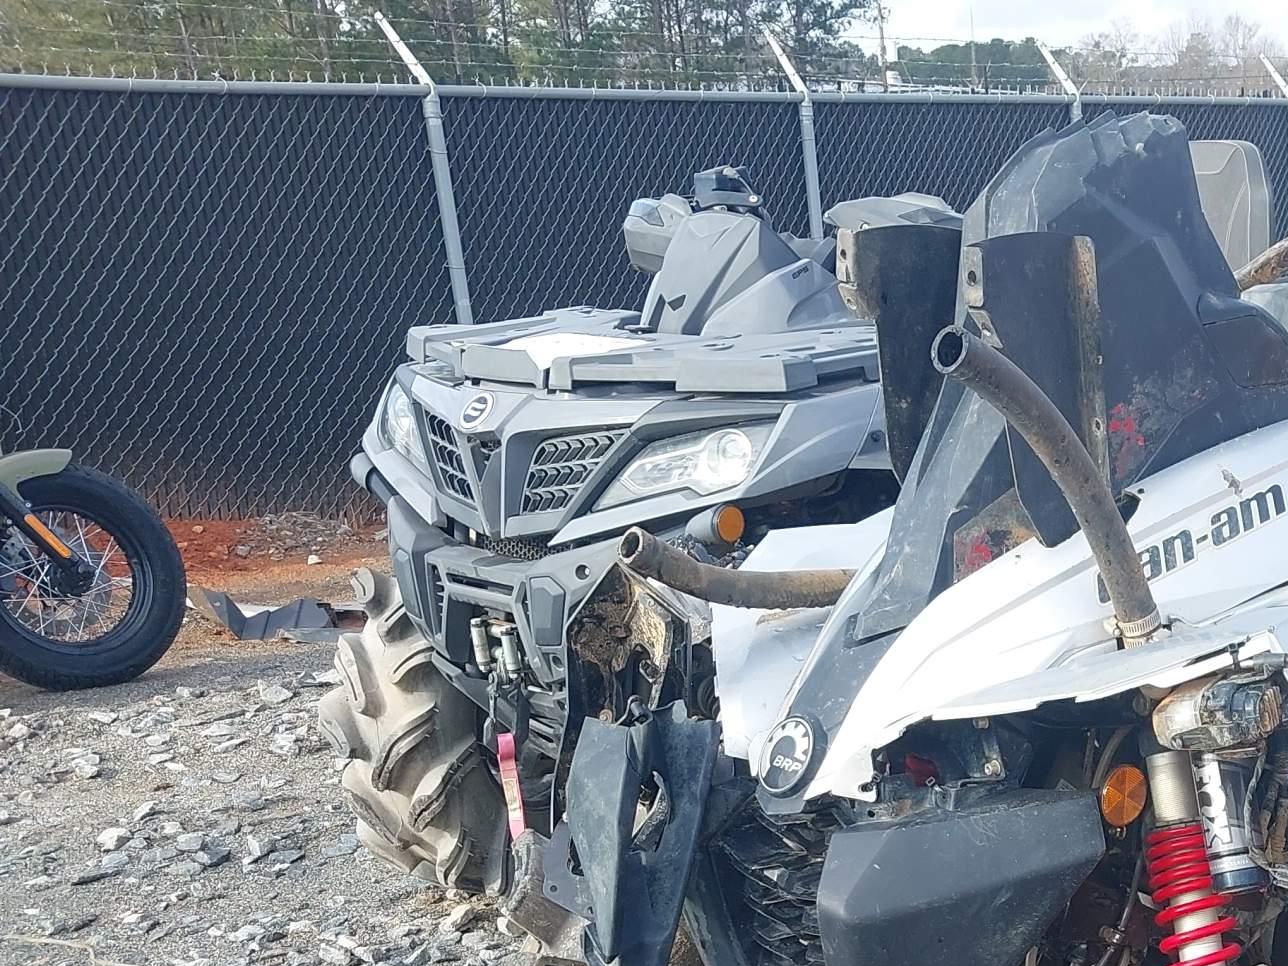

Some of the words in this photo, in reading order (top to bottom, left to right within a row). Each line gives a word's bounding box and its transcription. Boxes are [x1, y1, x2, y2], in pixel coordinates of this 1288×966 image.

[1096, 483, 1287, 604] an-am
[772, 754, 803, 772] BRP
[1193, 760, 1233, 849] FOX
